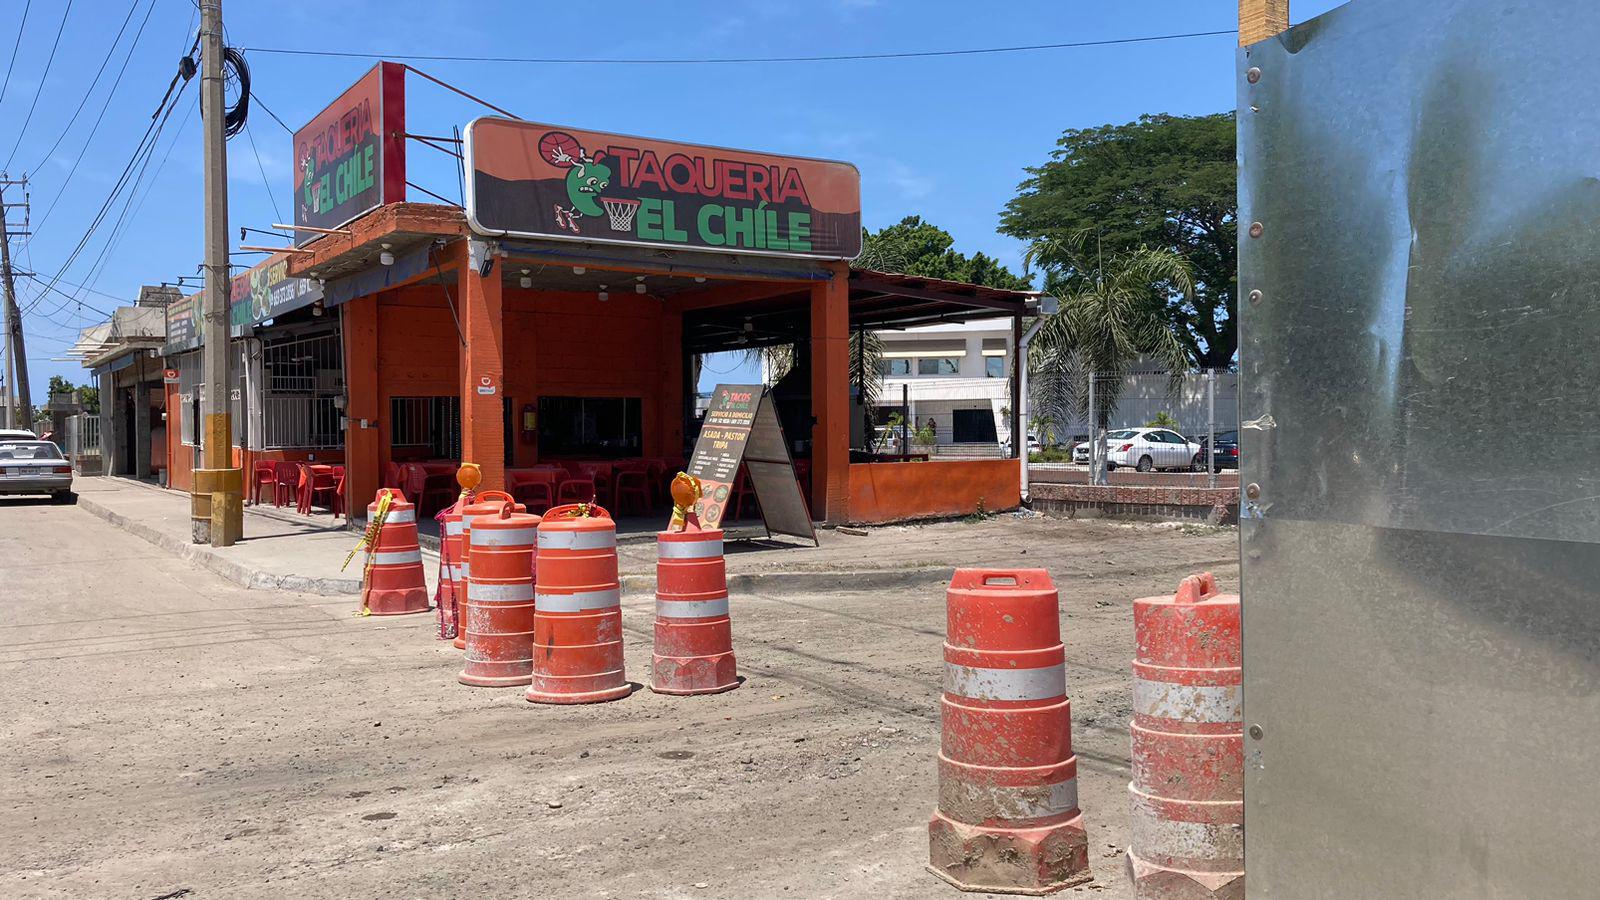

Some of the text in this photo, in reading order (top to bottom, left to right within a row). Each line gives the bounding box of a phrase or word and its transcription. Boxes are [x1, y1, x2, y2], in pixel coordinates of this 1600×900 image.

[313, 98, 372, 172] TAQUERIA
[320, 173, 334, 215] EL
[607, 145, 812, 207] TAQUERIA
[636, 197, 812, 252] EL CHÍLE
[730, 392, 752, 402] TACOS
[703, 430, 721, 439] ASADA
[724, 431, 746, 441] PASTOR
[712, 441, 729, 449] TRIPA
